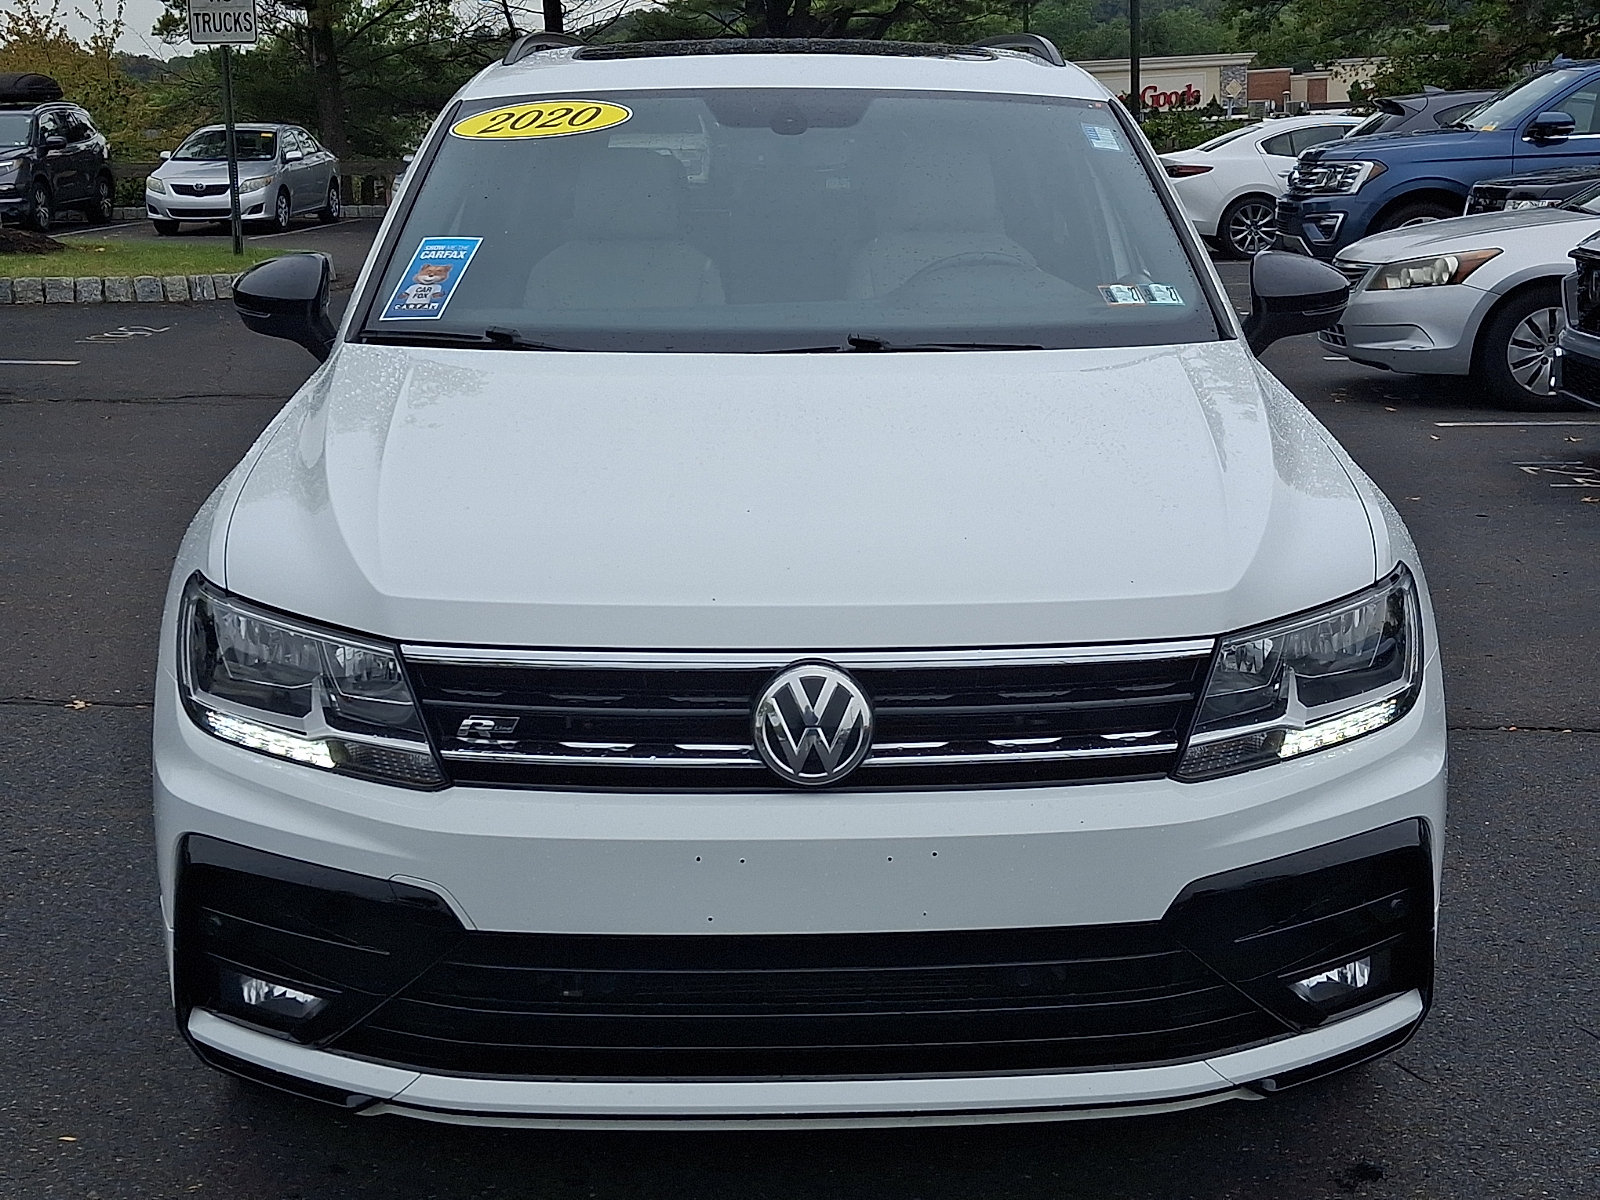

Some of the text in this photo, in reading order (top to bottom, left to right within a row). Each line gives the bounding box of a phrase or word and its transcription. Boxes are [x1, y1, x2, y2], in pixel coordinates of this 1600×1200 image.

[193, 12, 253, 33] TRUCKS
[1141, 84, 1201, 108] Goods
[477, 107, 602, 134] 2020
[420, 250, 467, 259] CARFAX
